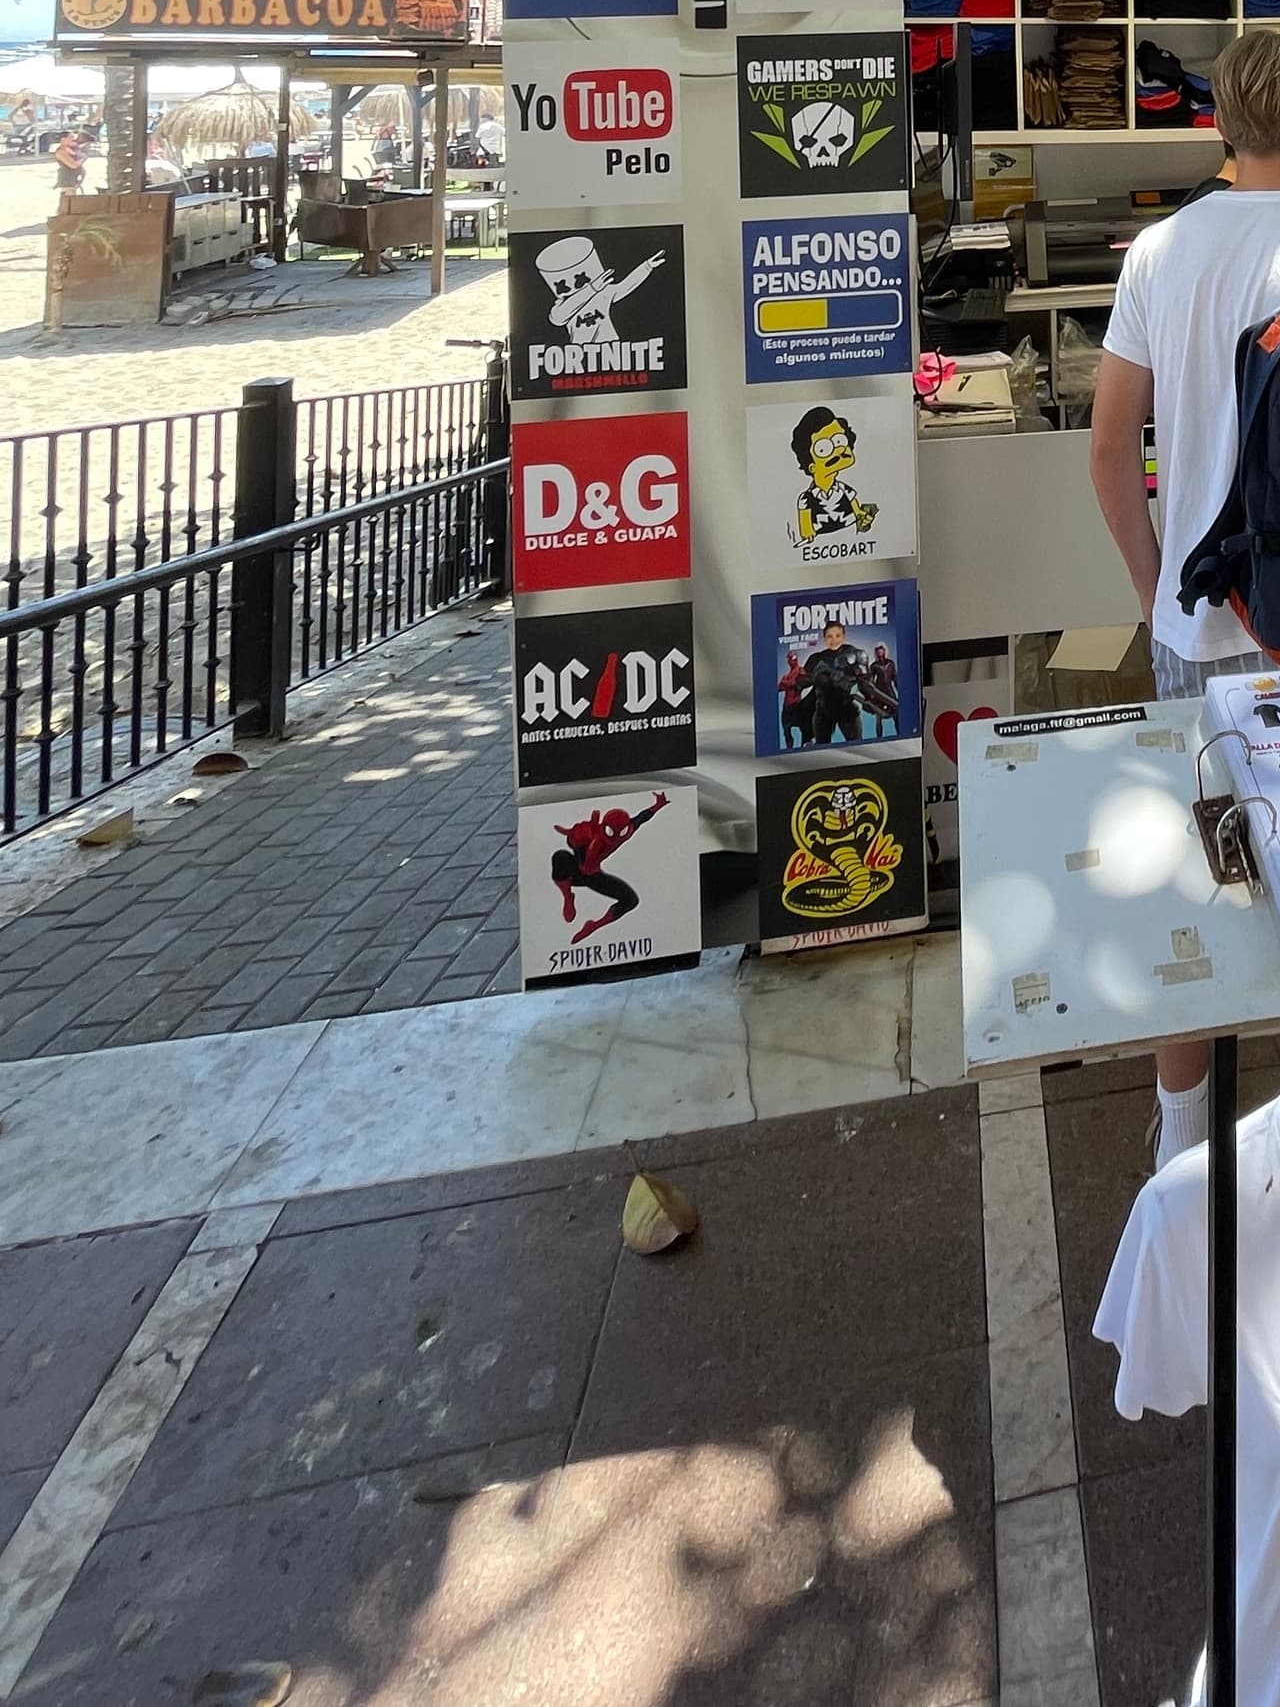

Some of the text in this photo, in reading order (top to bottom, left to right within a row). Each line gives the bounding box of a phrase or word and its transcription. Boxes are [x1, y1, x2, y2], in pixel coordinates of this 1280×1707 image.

[747, 57, 833, 85] GAMERS
[863, 56, 896, 79] DIE
[510, 79, 666, 132] Yo Tube
[748, 81, 896, 103] WE RESPAWN
[605, 147, 671, 176] Pelo
[752, 228, 901, 268] ALFONSO
[752, 266, 902, 295] PENSANDO...
[528, 337, 665, 381] FORTNITE
[775, 350, 827, 366] algunos
[522, 454, 680, 537] D&G
[525, 525, 678, 552] DULCE & GUAPA
[801, 541, 878, 562] ESCOBART
[783, 596, 888, 636] FORTNITE
[521, 730, 551, 744] ANTES
[608, 718, 649, 734] DESPUES
[651, 713, 692, 728] CUBATAS
